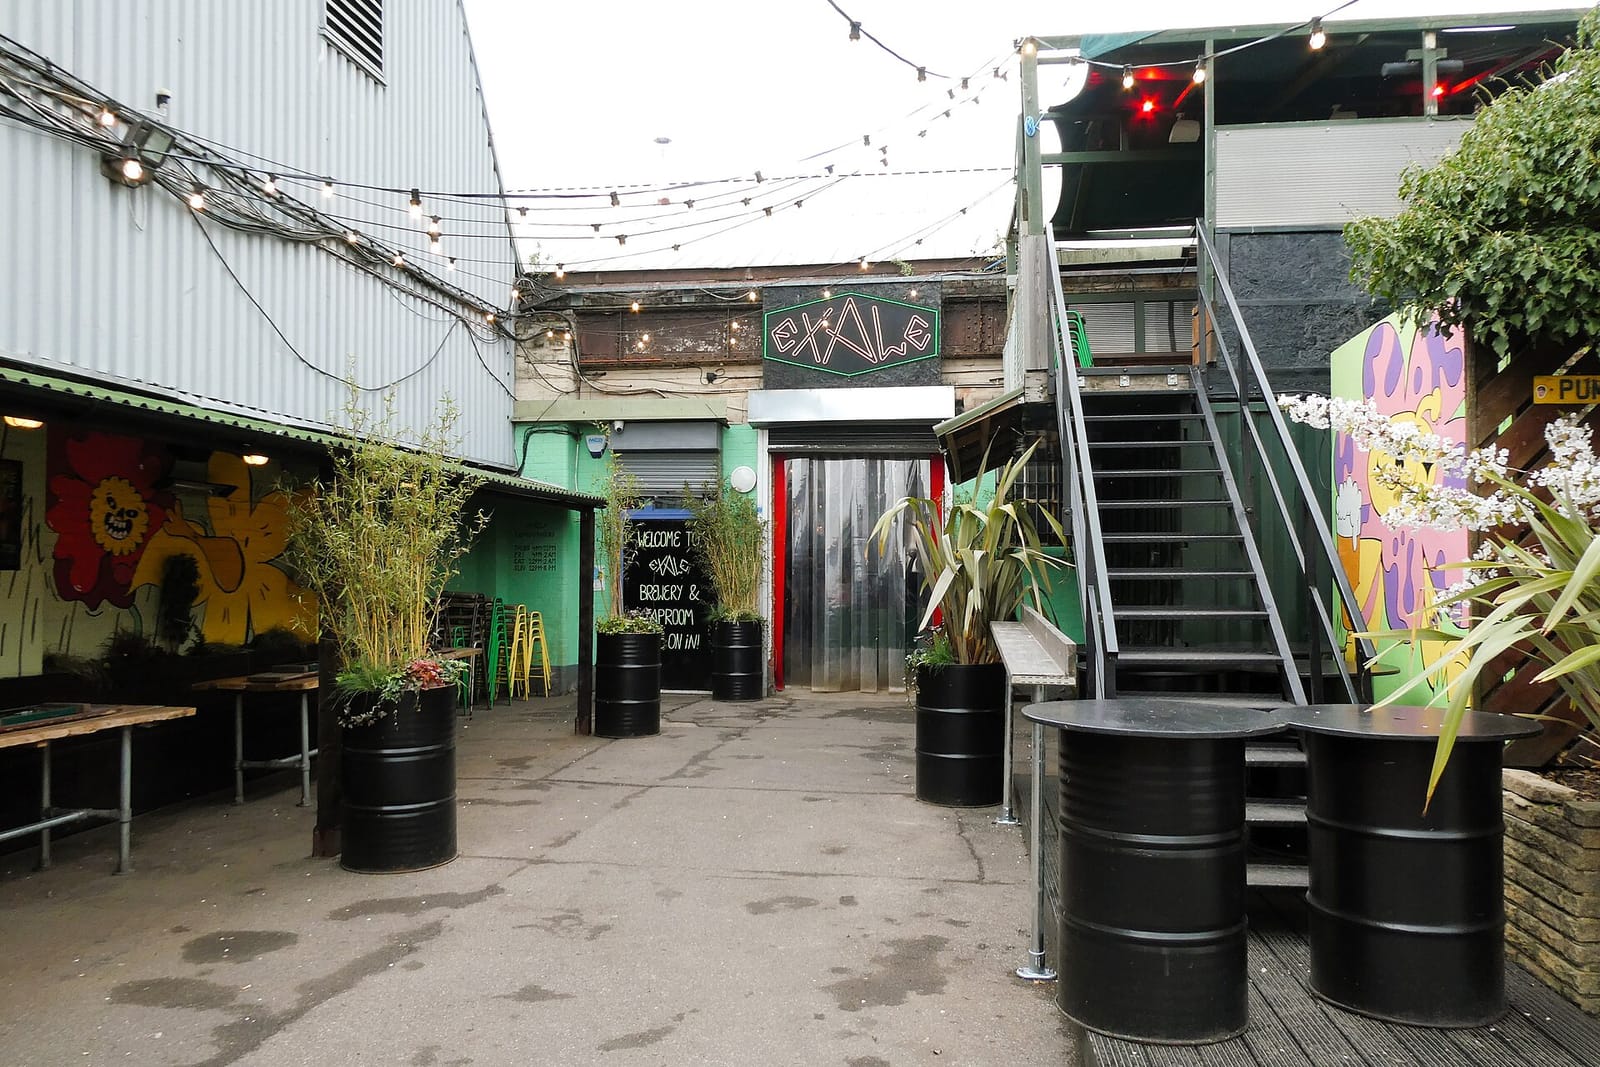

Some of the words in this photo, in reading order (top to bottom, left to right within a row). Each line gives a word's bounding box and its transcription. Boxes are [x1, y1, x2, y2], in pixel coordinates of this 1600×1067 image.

[771, 297, 931, 365] EXALE
[637, 530, 681, 547] WELCOME
[640, 584, 683, 600] BREWERY
[689, 584, 700, 600] &
[650, 608, 694, 625] APROOM
[667, 633, 682, 650] ON
